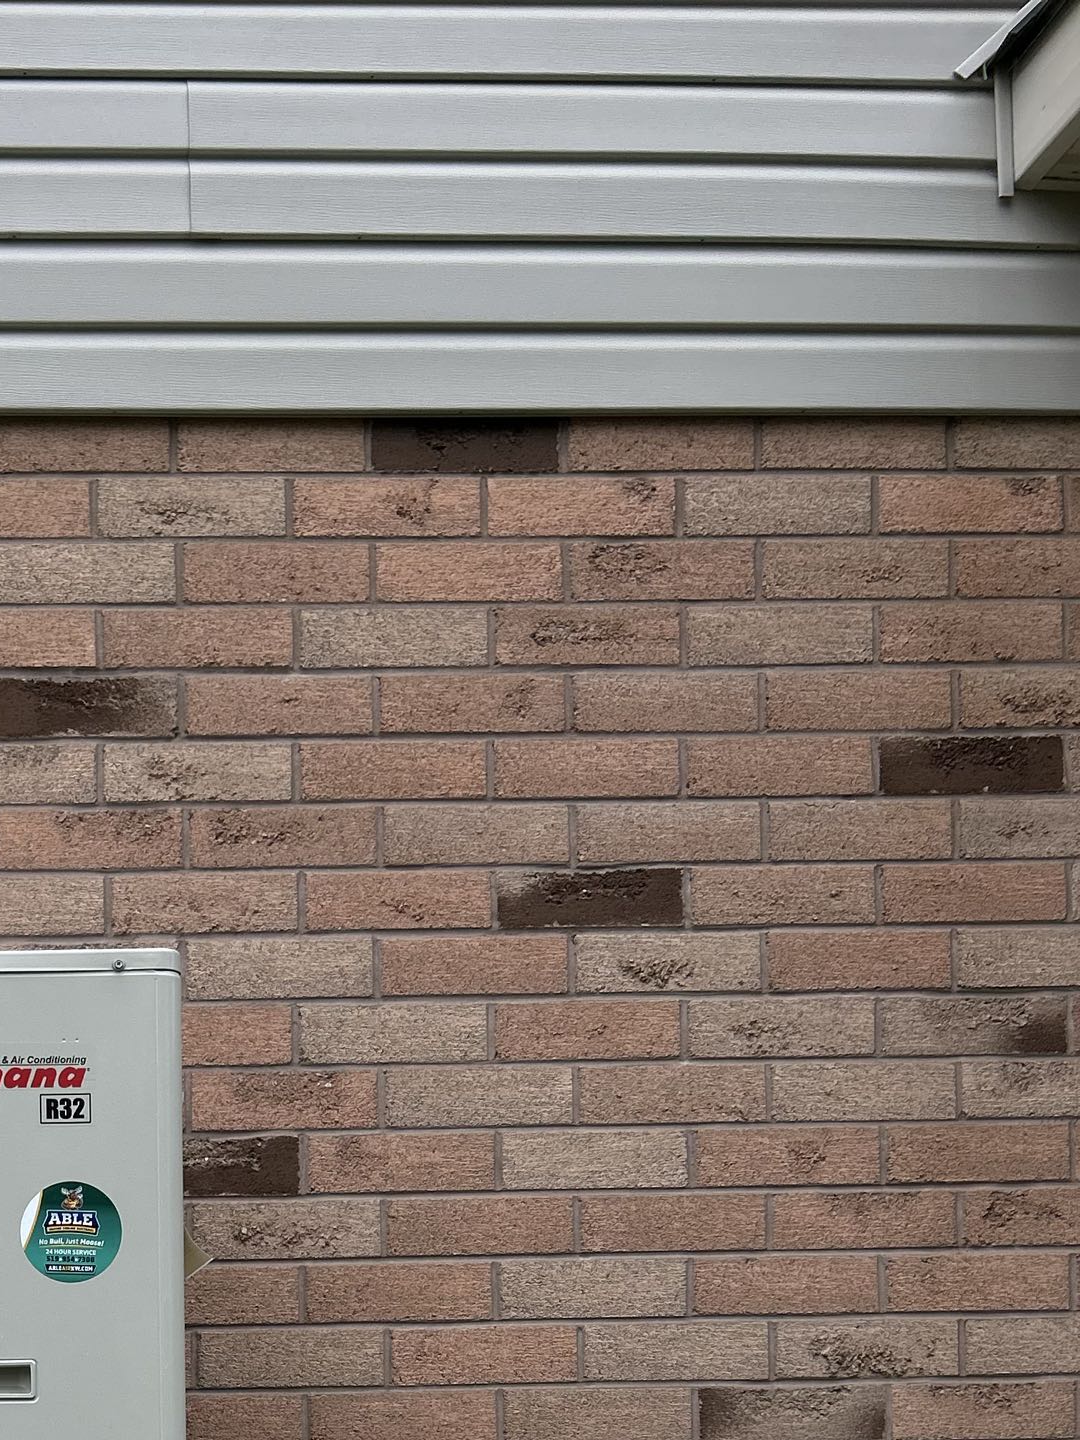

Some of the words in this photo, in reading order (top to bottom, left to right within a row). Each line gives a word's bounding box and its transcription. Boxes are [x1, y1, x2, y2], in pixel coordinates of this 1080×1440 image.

[1, 1056, 9, 1064] &
[10, 1055, 25, 1064] Air
[27, 1055, 87, 1065] Conditioning
[45, 1097, 85, 1120] R32
[48, 1212, 93, 1226] ABLE
